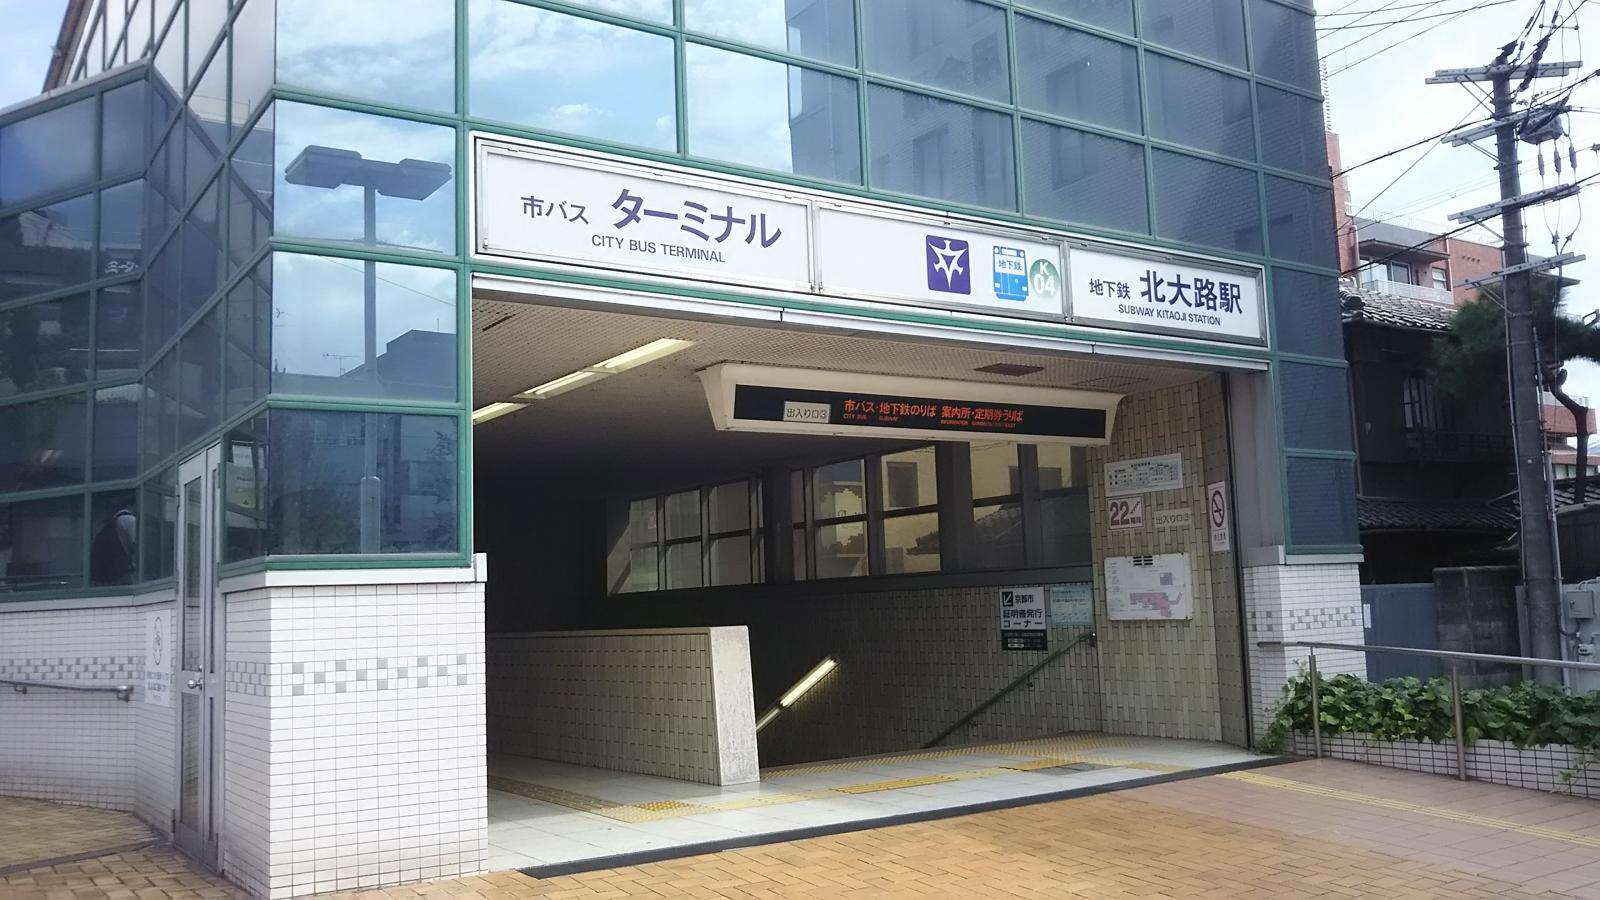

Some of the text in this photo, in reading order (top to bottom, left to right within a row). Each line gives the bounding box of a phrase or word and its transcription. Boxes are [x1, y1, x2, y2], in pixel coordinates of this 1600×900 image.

[521, 188, 782, 249] 市バス ターミナル
[591, 234, 726, 264] CITY BUS TERMINAL
[998, 258, 1022, 271] 地下鉄
[1039, 261, 1050, 276] K
[1033, 273, 1056, 296] 04
[1089, 269, 1243, 315] 地下鉄 北大路駅
[1118, 303, 1221, 327] SUBWAY KITAOJI STATION
[1003, 619, 1043, 628] コーナー
